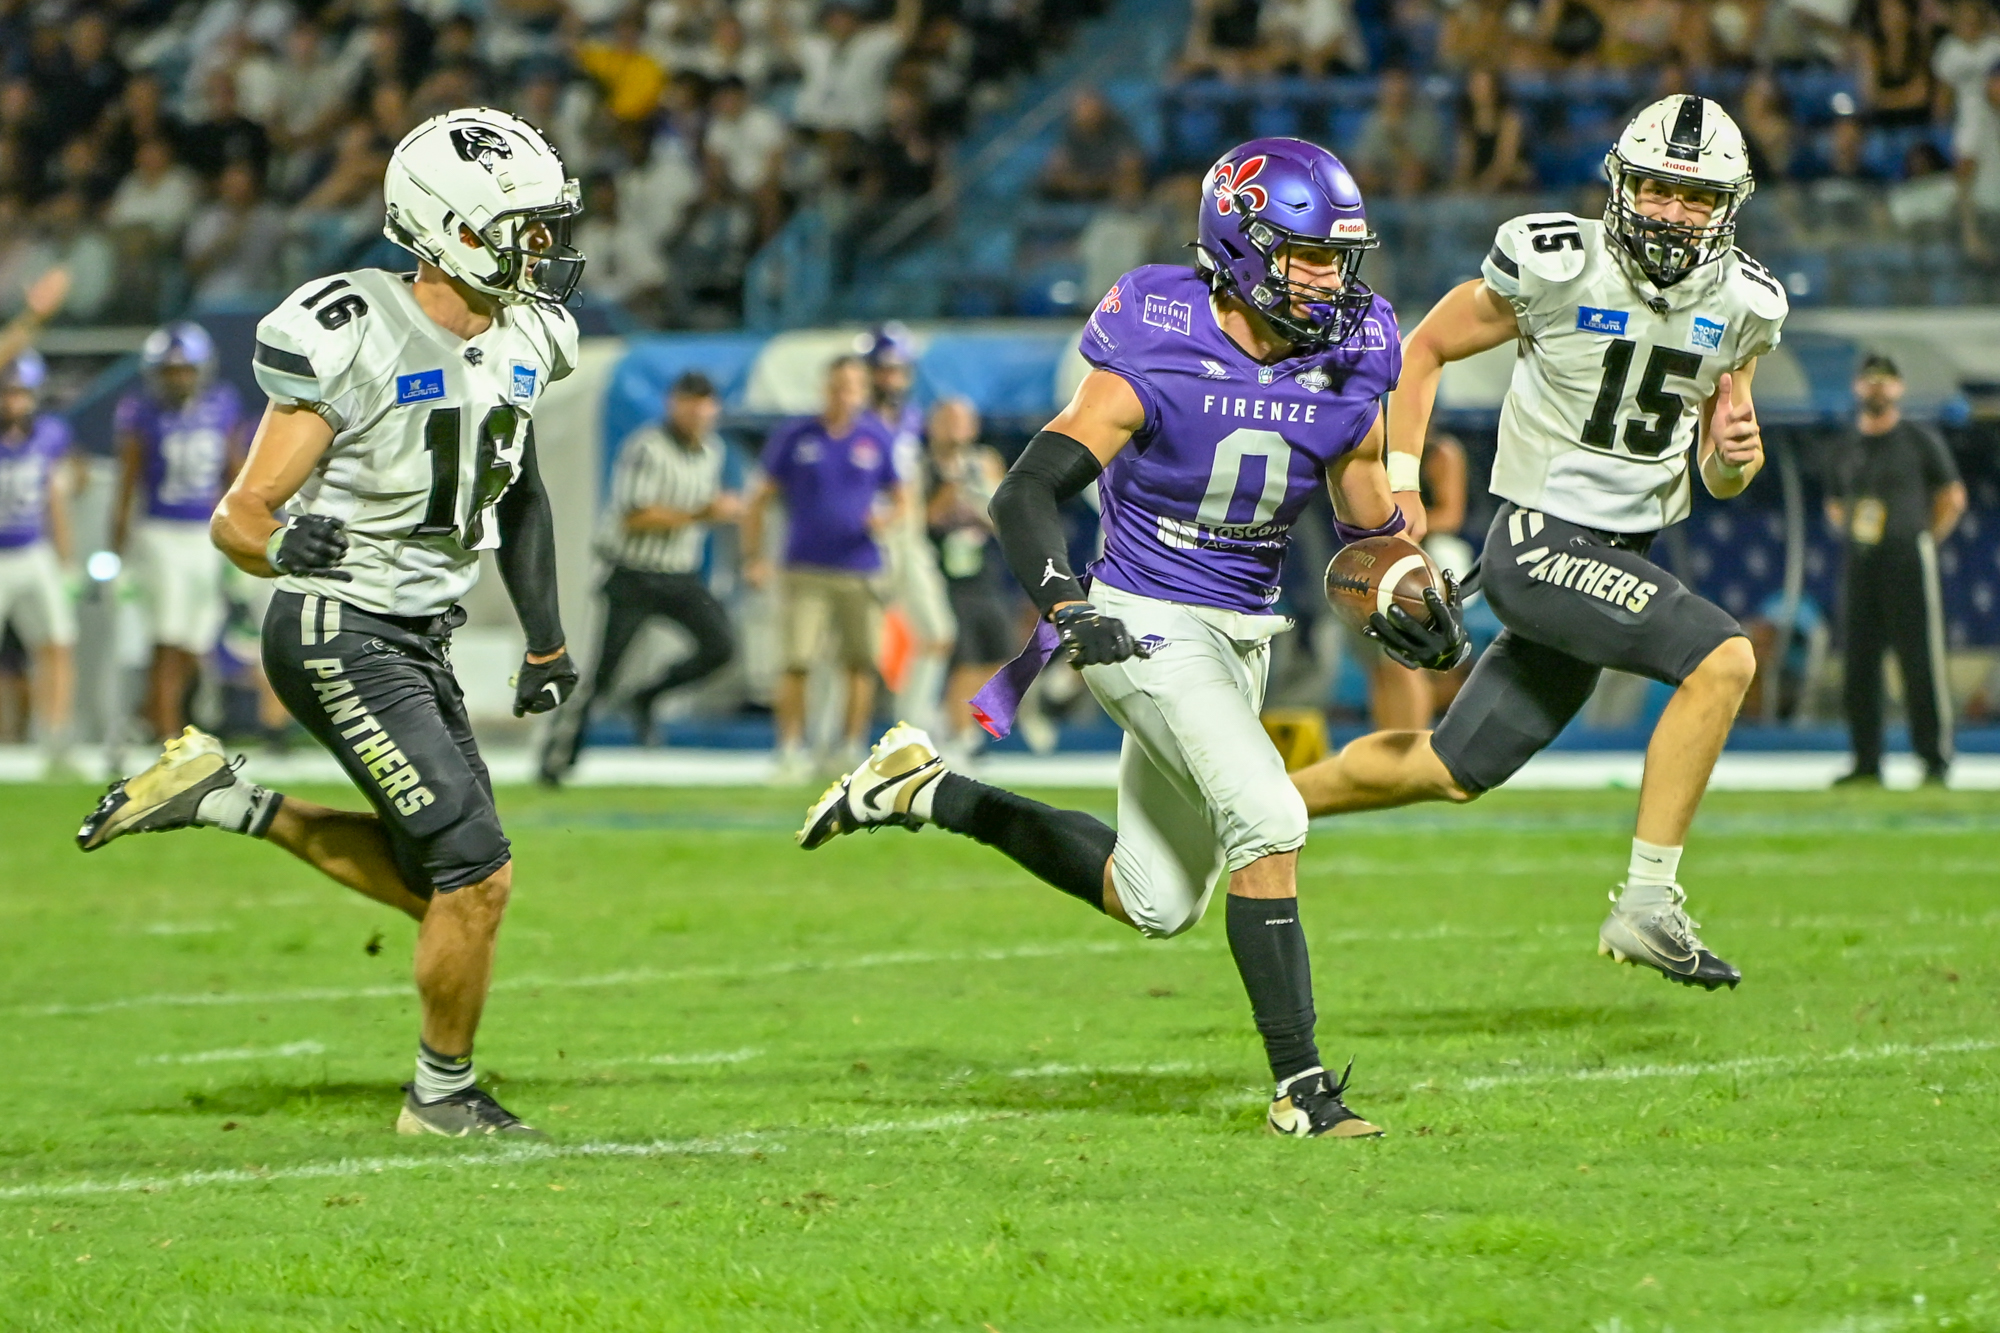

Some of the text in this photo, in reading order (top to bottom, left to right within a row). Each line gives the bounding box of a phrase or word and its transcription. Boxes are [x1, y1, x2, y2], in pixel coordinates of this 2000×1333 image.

[1662, 161, 1699, 173] Riddell
[1339, 224, 1365, 233] Riddell
[1526, 219, 1585, 254] 15
[299, 279, 370, 331] 16
[1203, 394, 1318, 424] FIRENZE
[1580, 338, 1703, 458] 15
[407, 404, 519, 549] 16
[1194, 427, 1292, 527] 0
[1515, 546, 1659, 614] PANTHERS
[302, 657, 437, 817] PANTHERS
